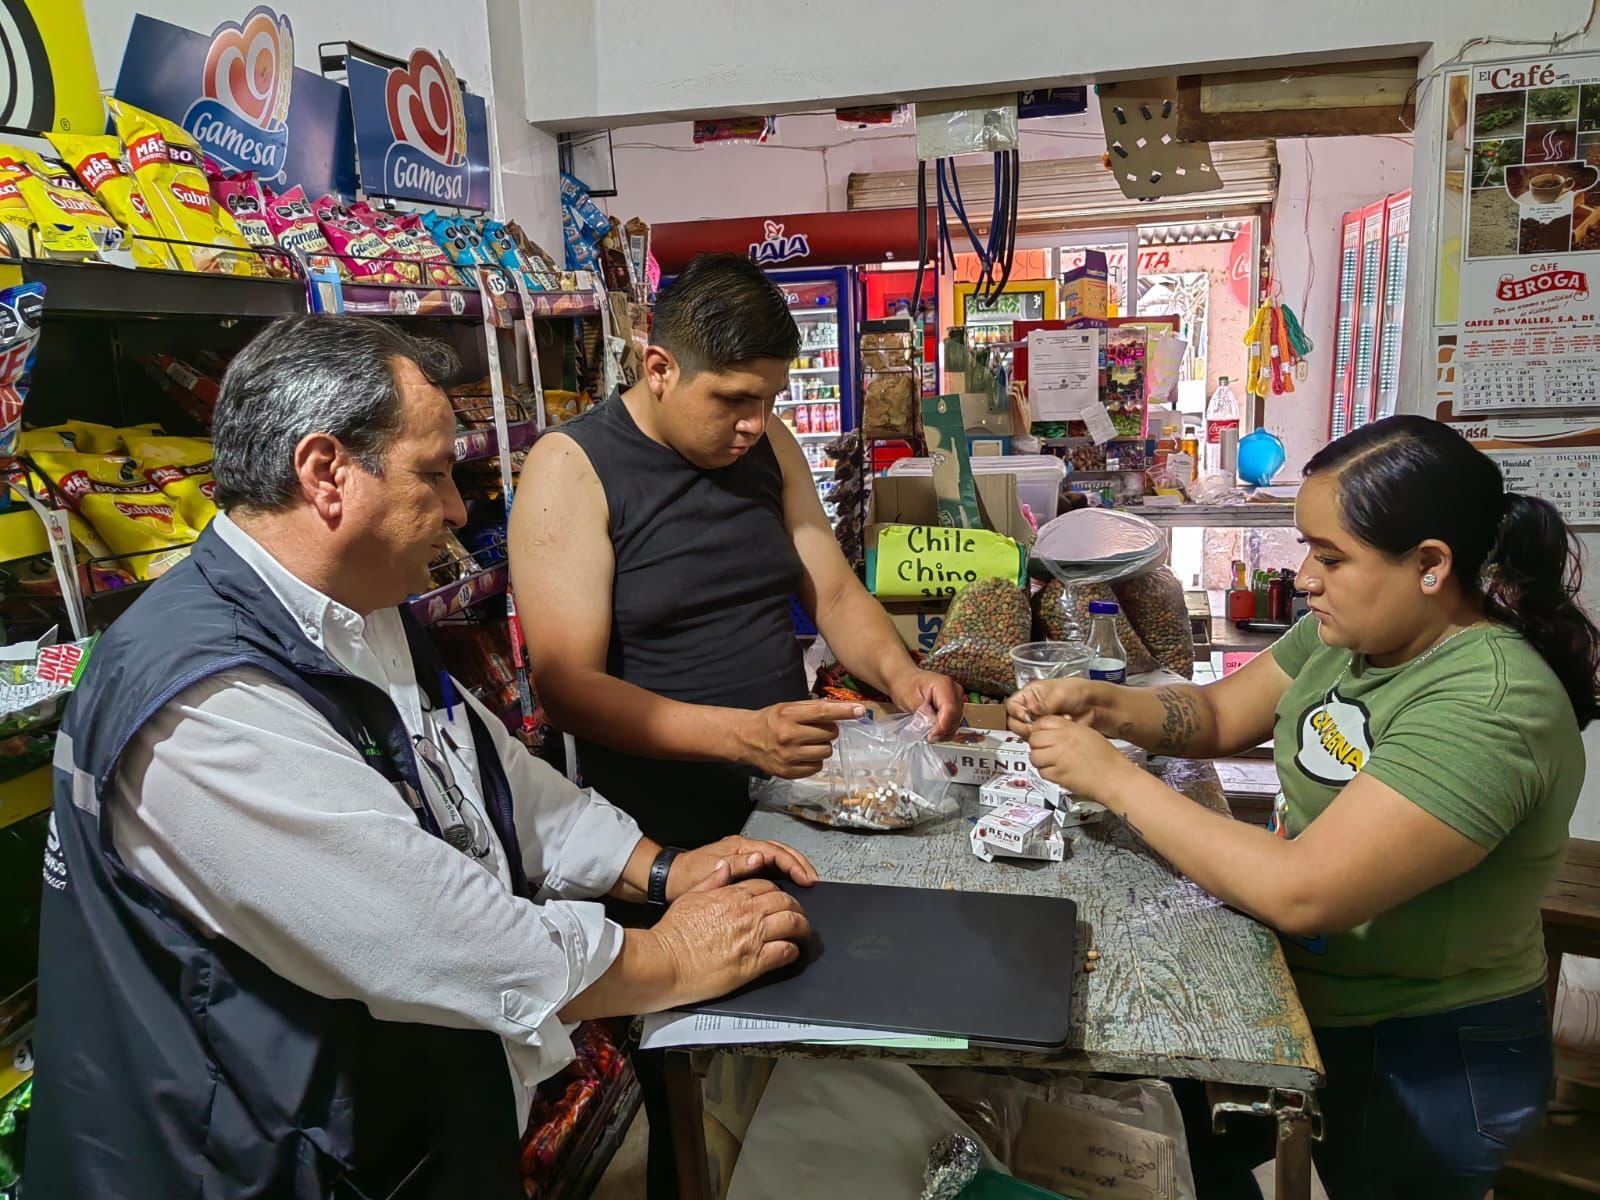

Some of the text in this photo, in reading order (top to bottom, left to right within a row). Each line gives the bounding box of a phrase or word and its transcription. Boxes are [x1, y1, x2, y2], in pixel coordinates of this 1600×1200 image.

[1479, 63, 1554, 89] El Café
[136, 137, 166, 158] MÁS
[193, 113, 277, 166] Gamesa
[82, 158, 113, 182] MÁS
[394, 156, 463, 200] Gamesa
[172, 187, 210, 205] Sabri
[750, 235, 809, 263] LALA
[1530, 263, 1558, 272] CAFE
[489, 275, 505, 293] $15
[1502, 273, 1580, 299] SEROGA
[1465, 319, 1494, 327] CAFES
[1514, 316, 1554, 325] VALLES,
[908, 527, 976, 553] Chile
[898, 558, 977, 582] Chino
[962, 756, 1027, 771] RENO
[989, 827, 1020, 842] RENO
